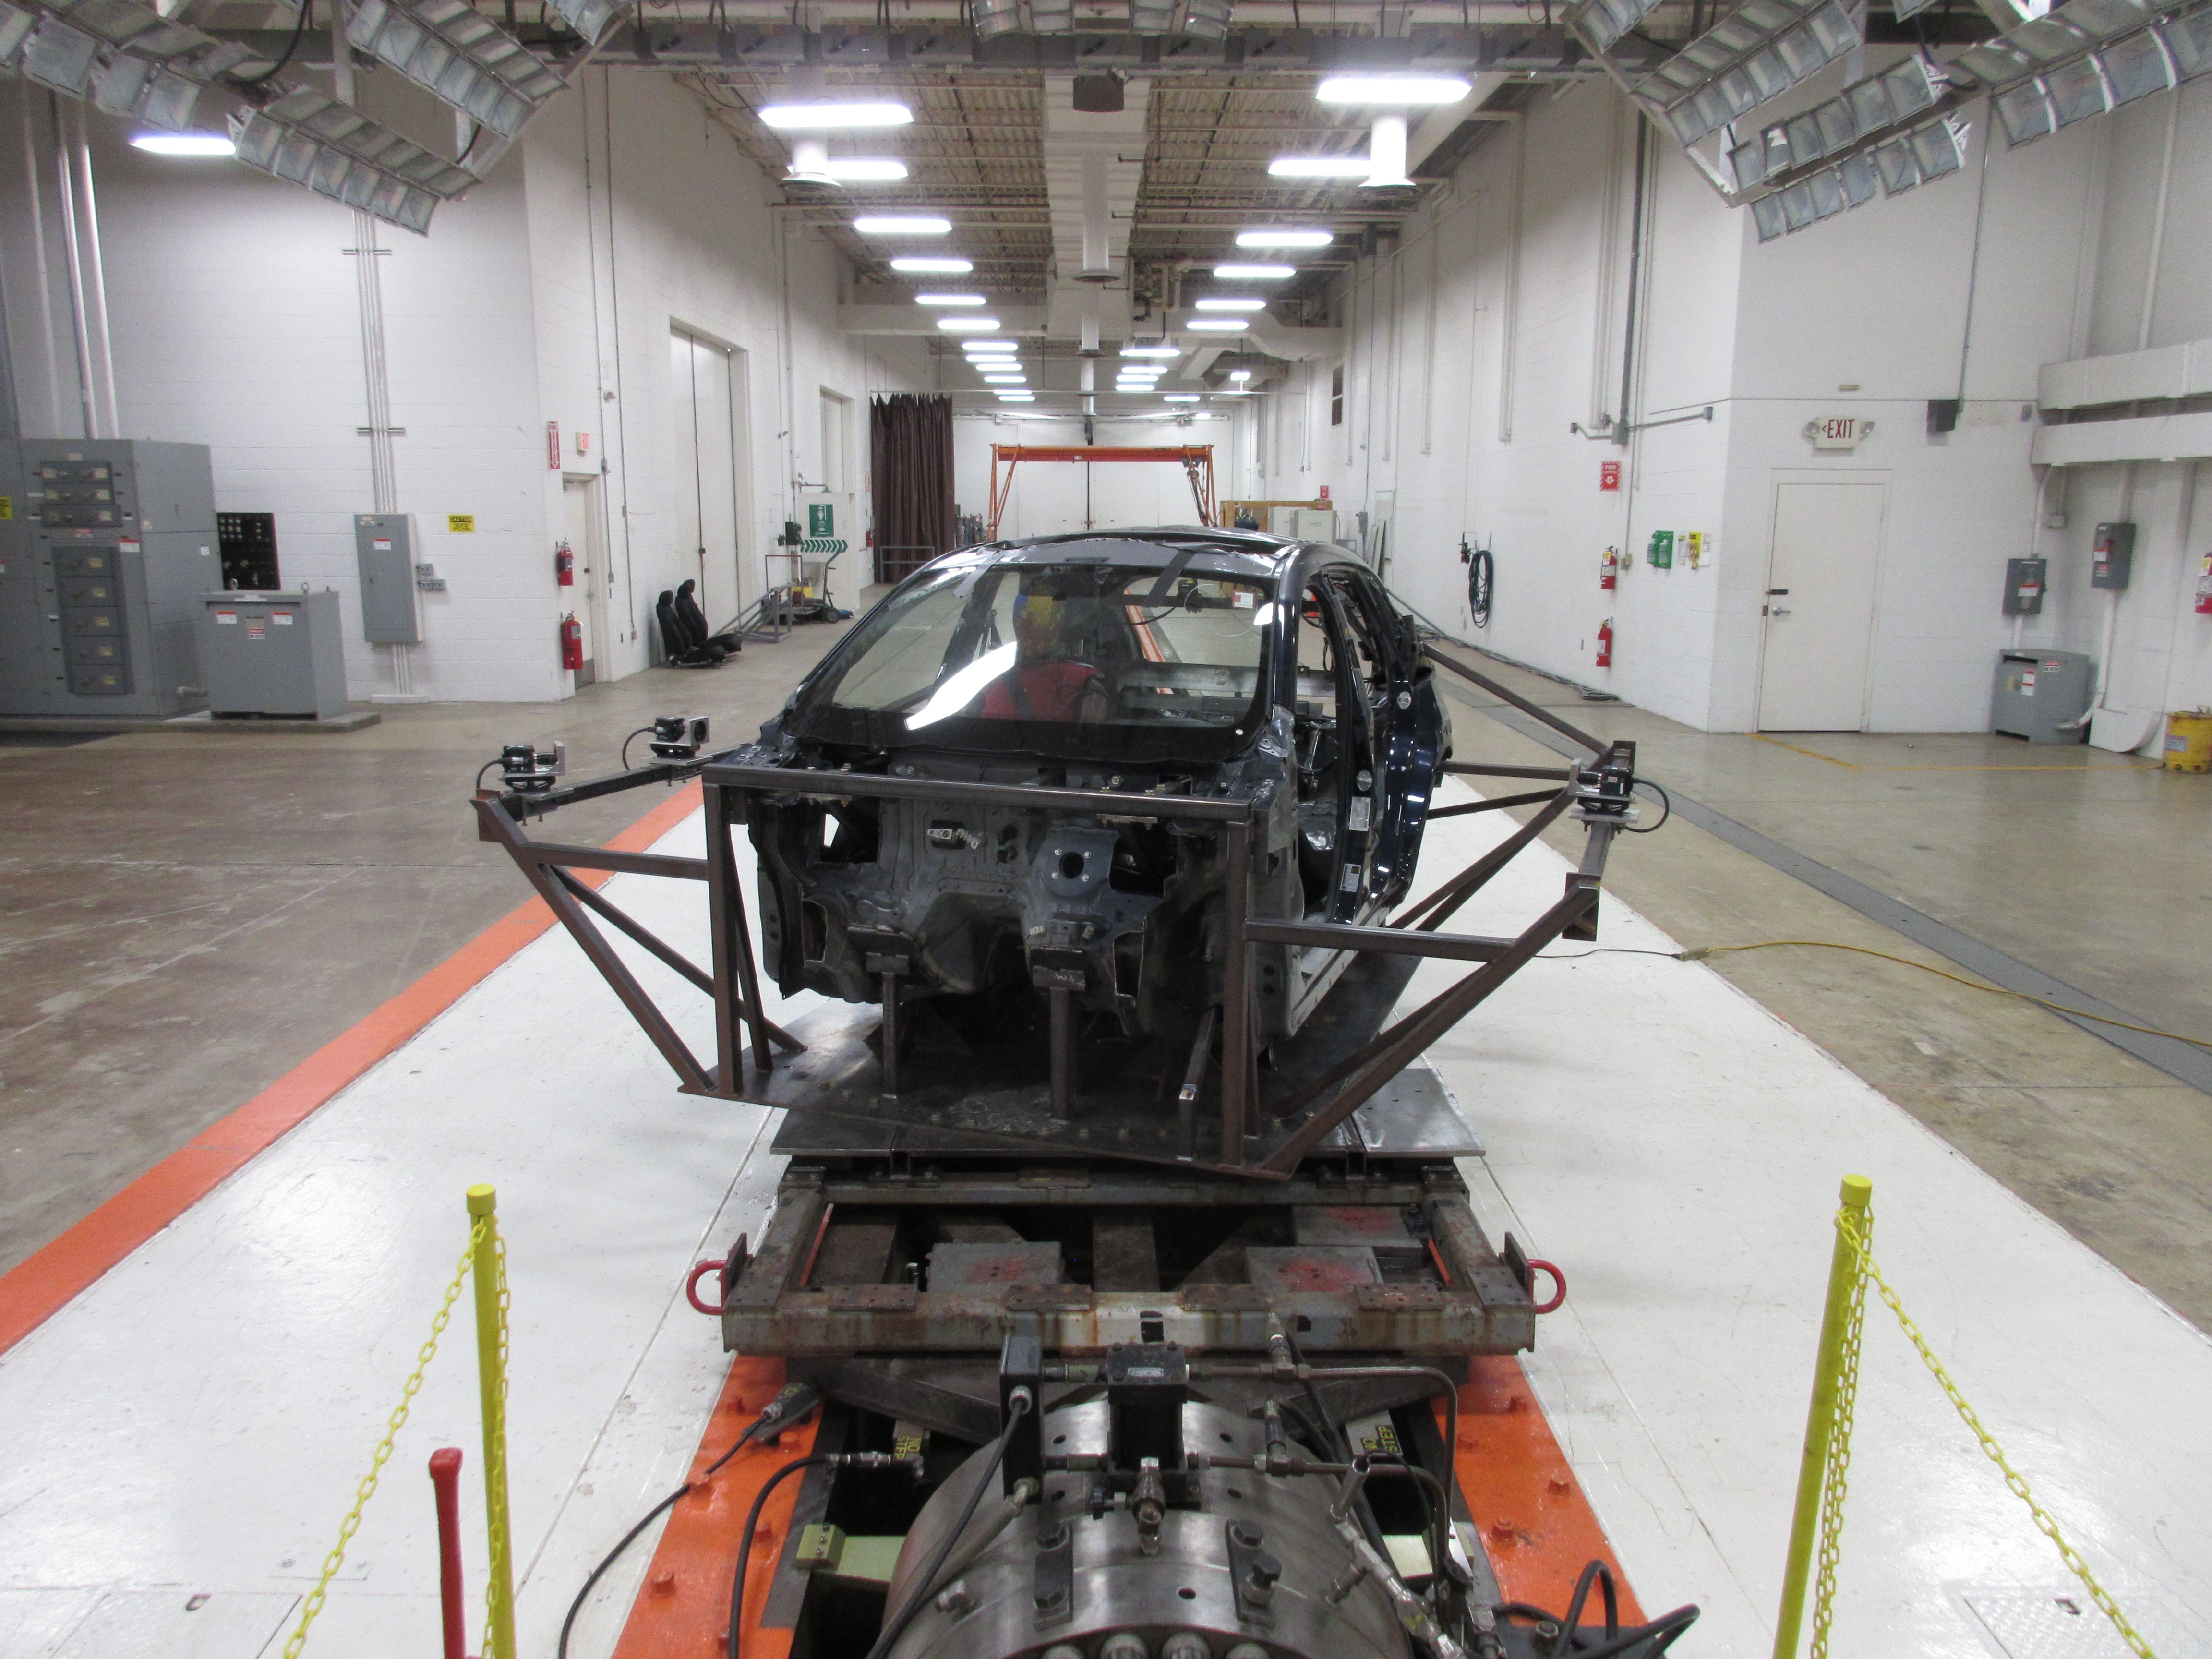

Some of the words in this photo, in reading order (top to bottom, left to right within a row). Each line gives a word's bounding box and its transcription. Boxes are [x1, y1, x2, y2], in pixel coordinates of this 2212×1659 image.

[1827, 419, 1854, 438] EXIT
[895, 1434, 910, 1459] STEP
[907, 1438, 922, 1452] NO
[1362, 1438, 1378, 1451] NO
[1378, 1426, 1398, 1452] STEP
